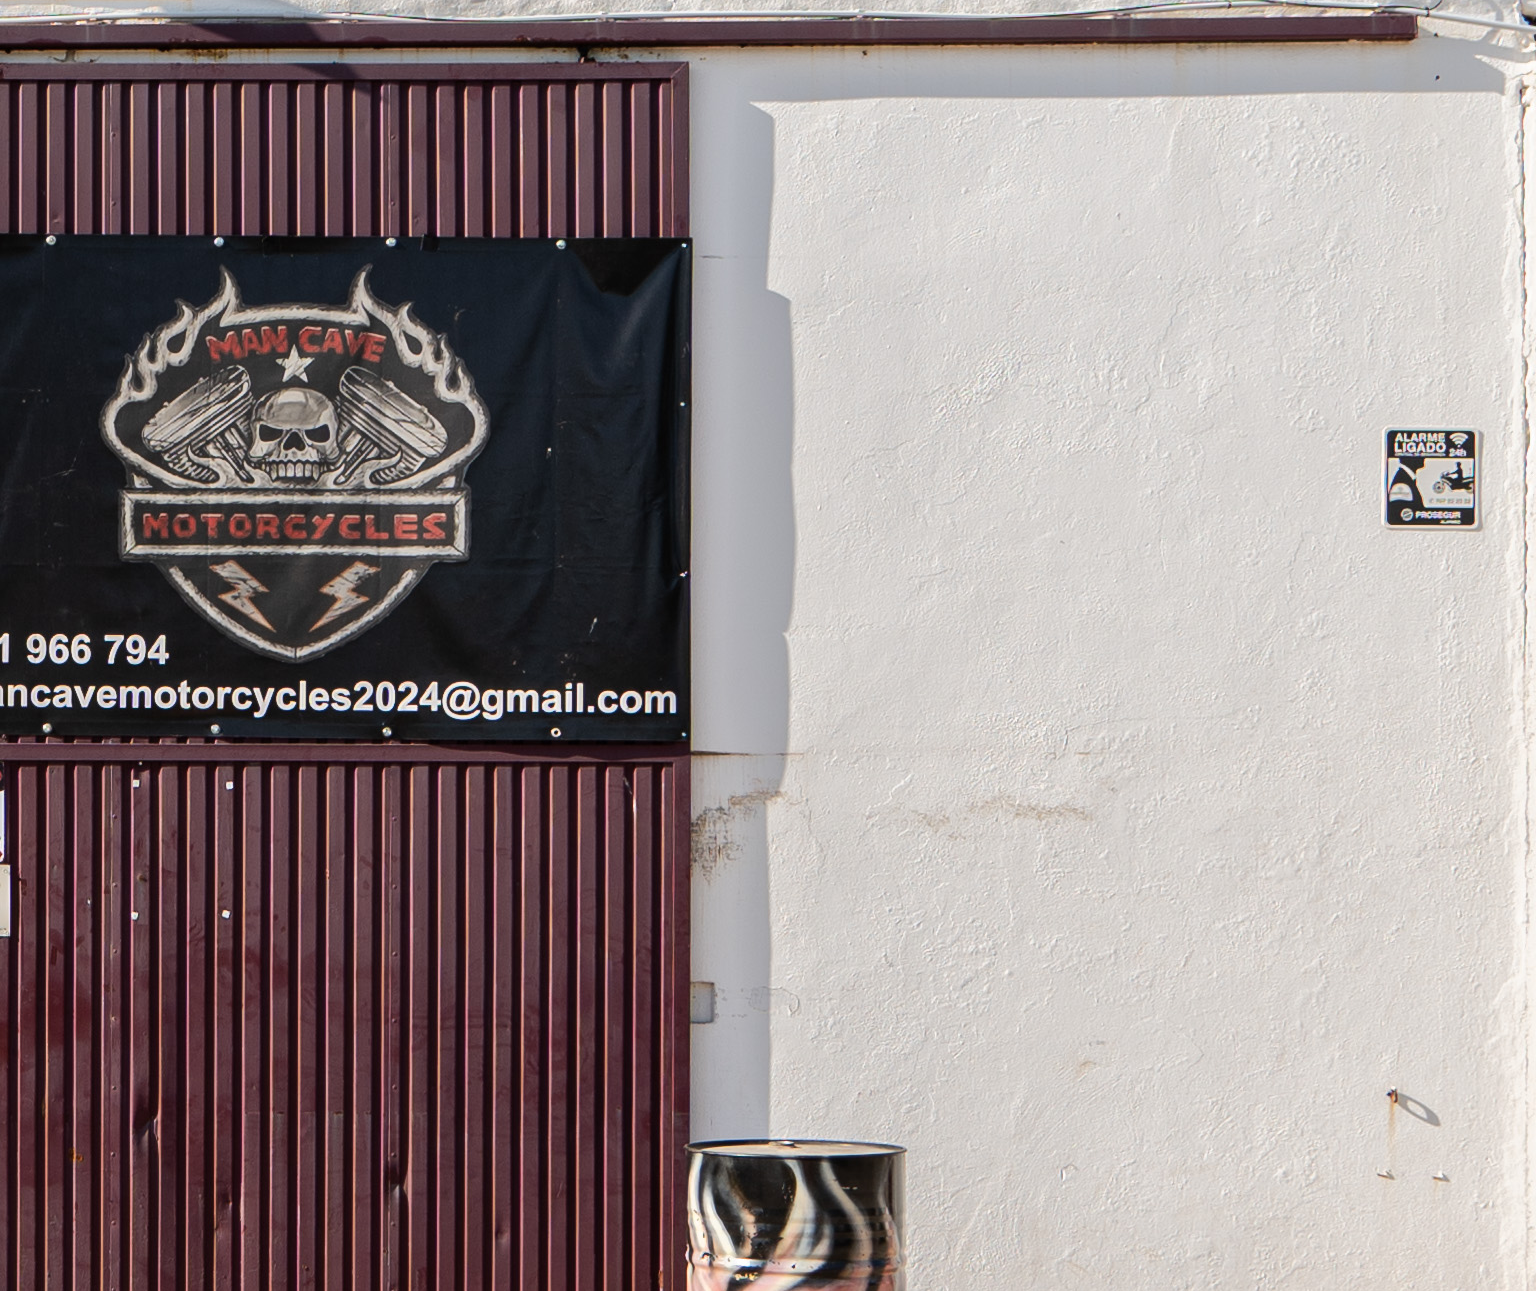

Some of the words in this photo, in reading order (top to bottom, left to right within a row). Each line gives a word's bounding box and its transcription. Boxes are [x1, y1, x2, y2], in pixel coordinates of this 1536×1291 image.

[208, 326, 288, 361] MAN
[299, 326, 385, 362] CAVE
[1394, 432, 1446, 442] ALARME
[1394, 442, 1446, 453] LIGADO
[143, 512, 446, 540] MOTORCYCLES
[26, 633, 92, 665] 966
[103, 634, 170, 665] 794
